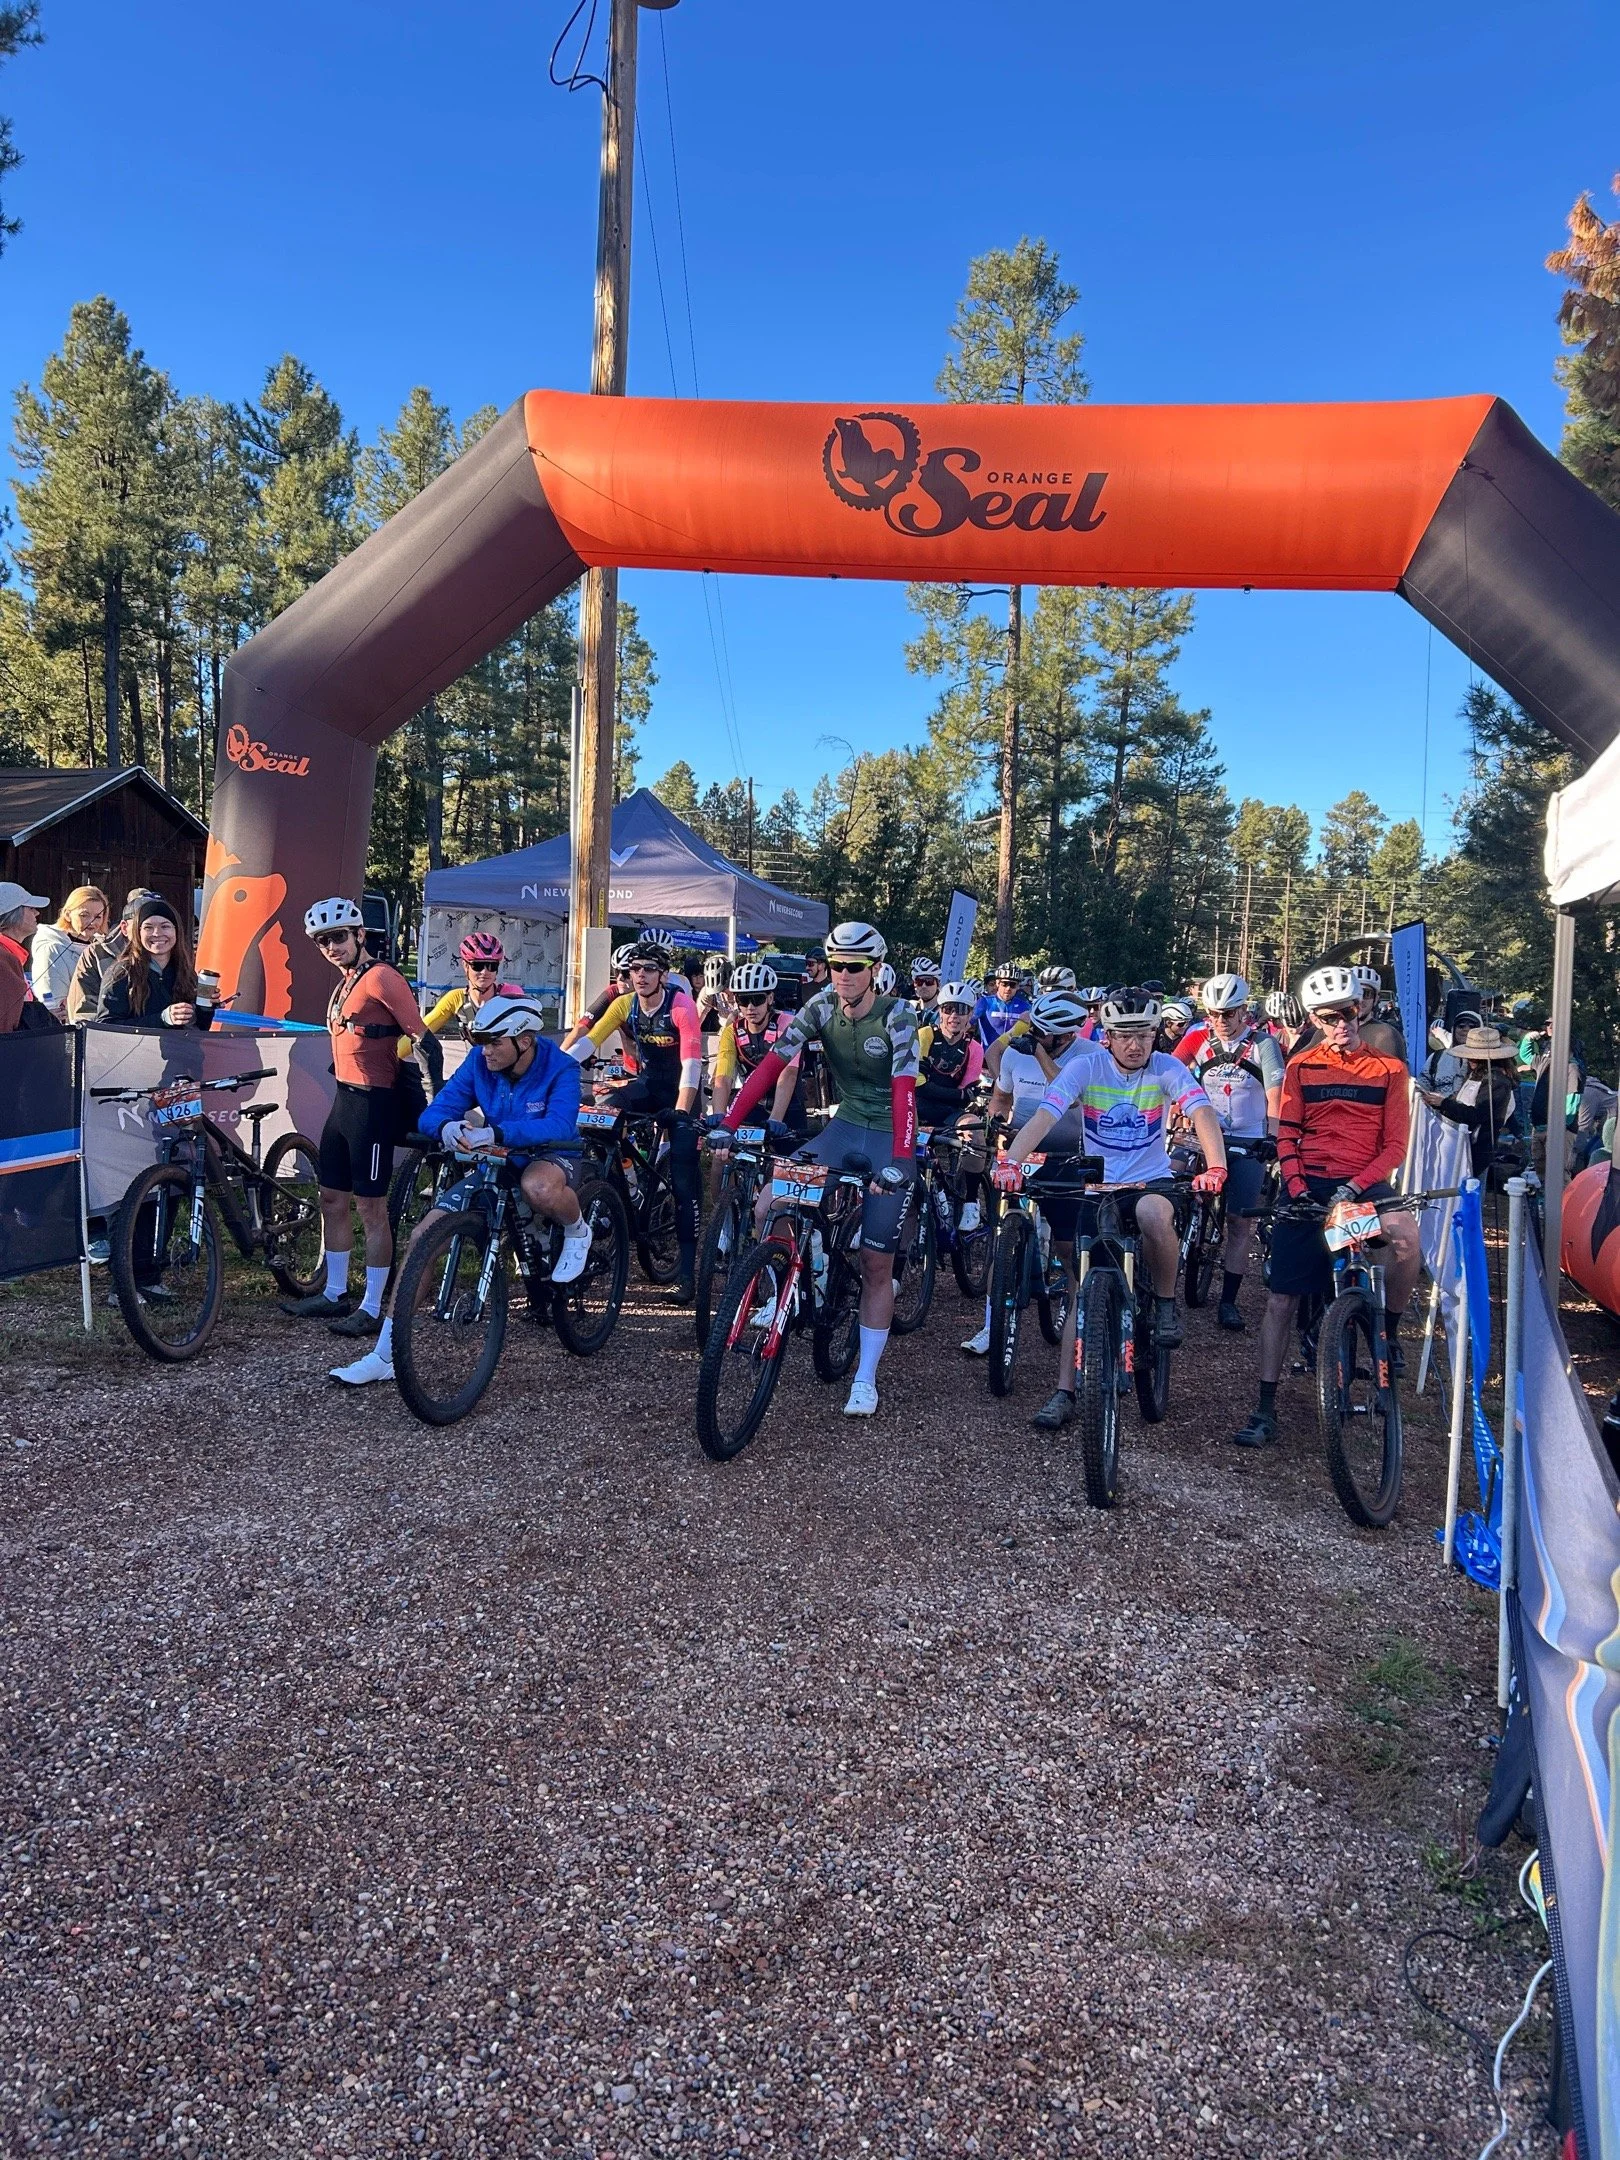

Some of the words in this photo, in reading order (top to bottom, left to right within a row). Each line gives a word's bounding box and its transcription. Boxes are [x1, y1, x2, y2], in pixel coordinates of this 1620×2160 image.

[987, 471, 1072, 485] ORANGE
[884, 447, 1109, 537] Seal
[239, 741, 311, 777] Seal
[268, 751, 298, 761] ORANGE
[543, 887, 633, 899] NEVOND
[586, 1114, 606, 1124] 138
[736, 1129, 756, 1140] 137
[903, 1111, 914, 1148] CALIFORNIA
[786, 1183, 808, 1198] 101
[893, 1181, 915, 1240] LANDIS
[692, 1199, 700, 1238] GATEWAY
[1343, 1221, 1361, 1236] 40
